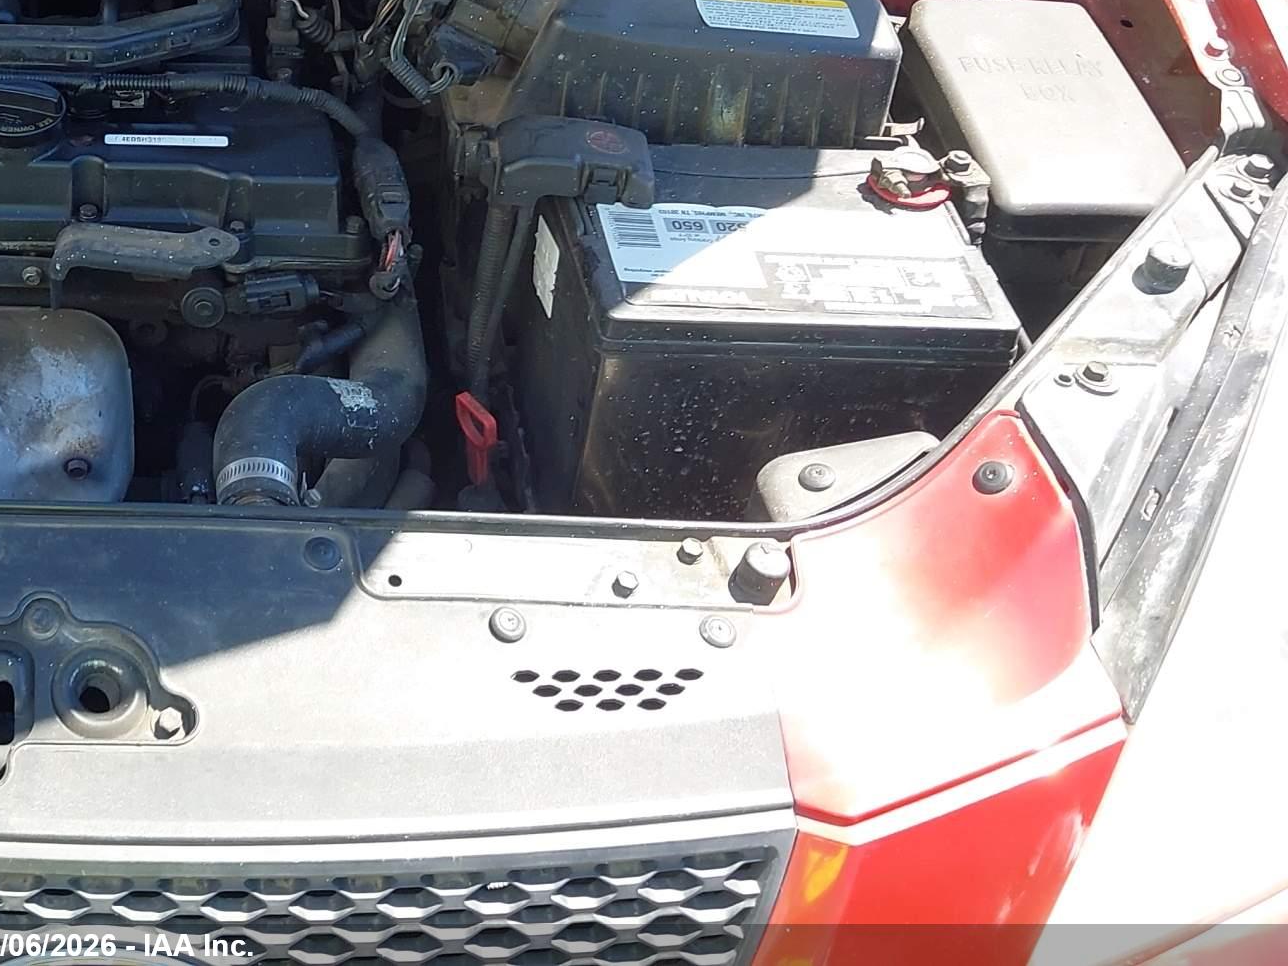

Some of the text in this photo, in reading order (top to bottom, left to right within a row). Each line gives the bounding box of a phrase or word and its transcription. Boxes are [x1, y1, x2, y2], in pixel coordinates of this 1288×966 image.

[958, 57, 1104, 77] FUSE RELAY
[1020, 82, 1076, 103] BOX
[671, 220, 704, 232] 650
